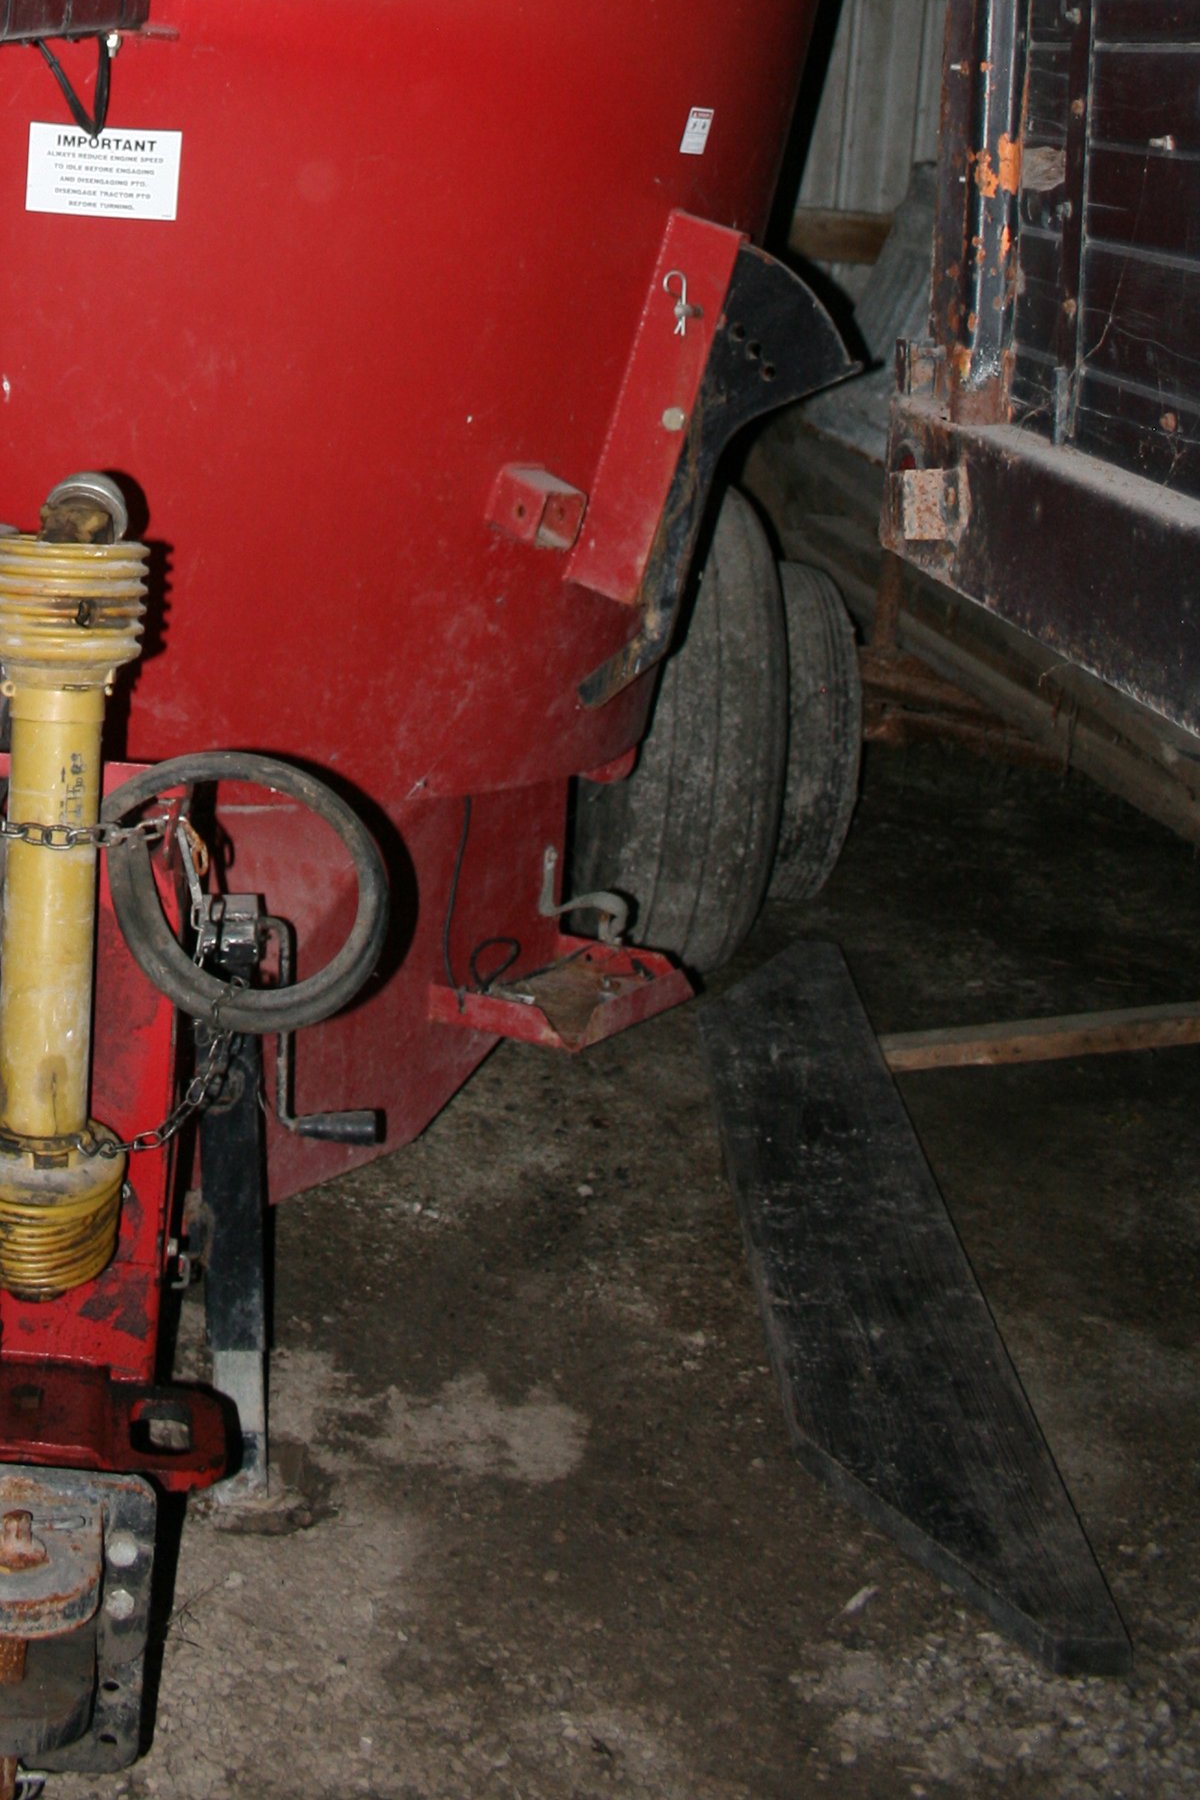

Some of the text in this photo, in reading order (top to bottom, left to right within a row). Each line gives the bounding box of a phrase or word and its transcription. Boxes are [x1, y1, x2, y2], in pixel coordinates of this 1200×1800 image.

[57, 134, 157, 152] IMPORTANT
[47, 150, 164, 164] ALWAYS REDUCE ENGINE SPEED
[84, 165, 113, 173] BEFORE
[116, 167, 155, 175] ENGAGING
[77, 177, 128, 186] DISENGAGING
[55, 188, 97, 196] DISENGAGE
[100, 191, 134, 199] TRACTOR
